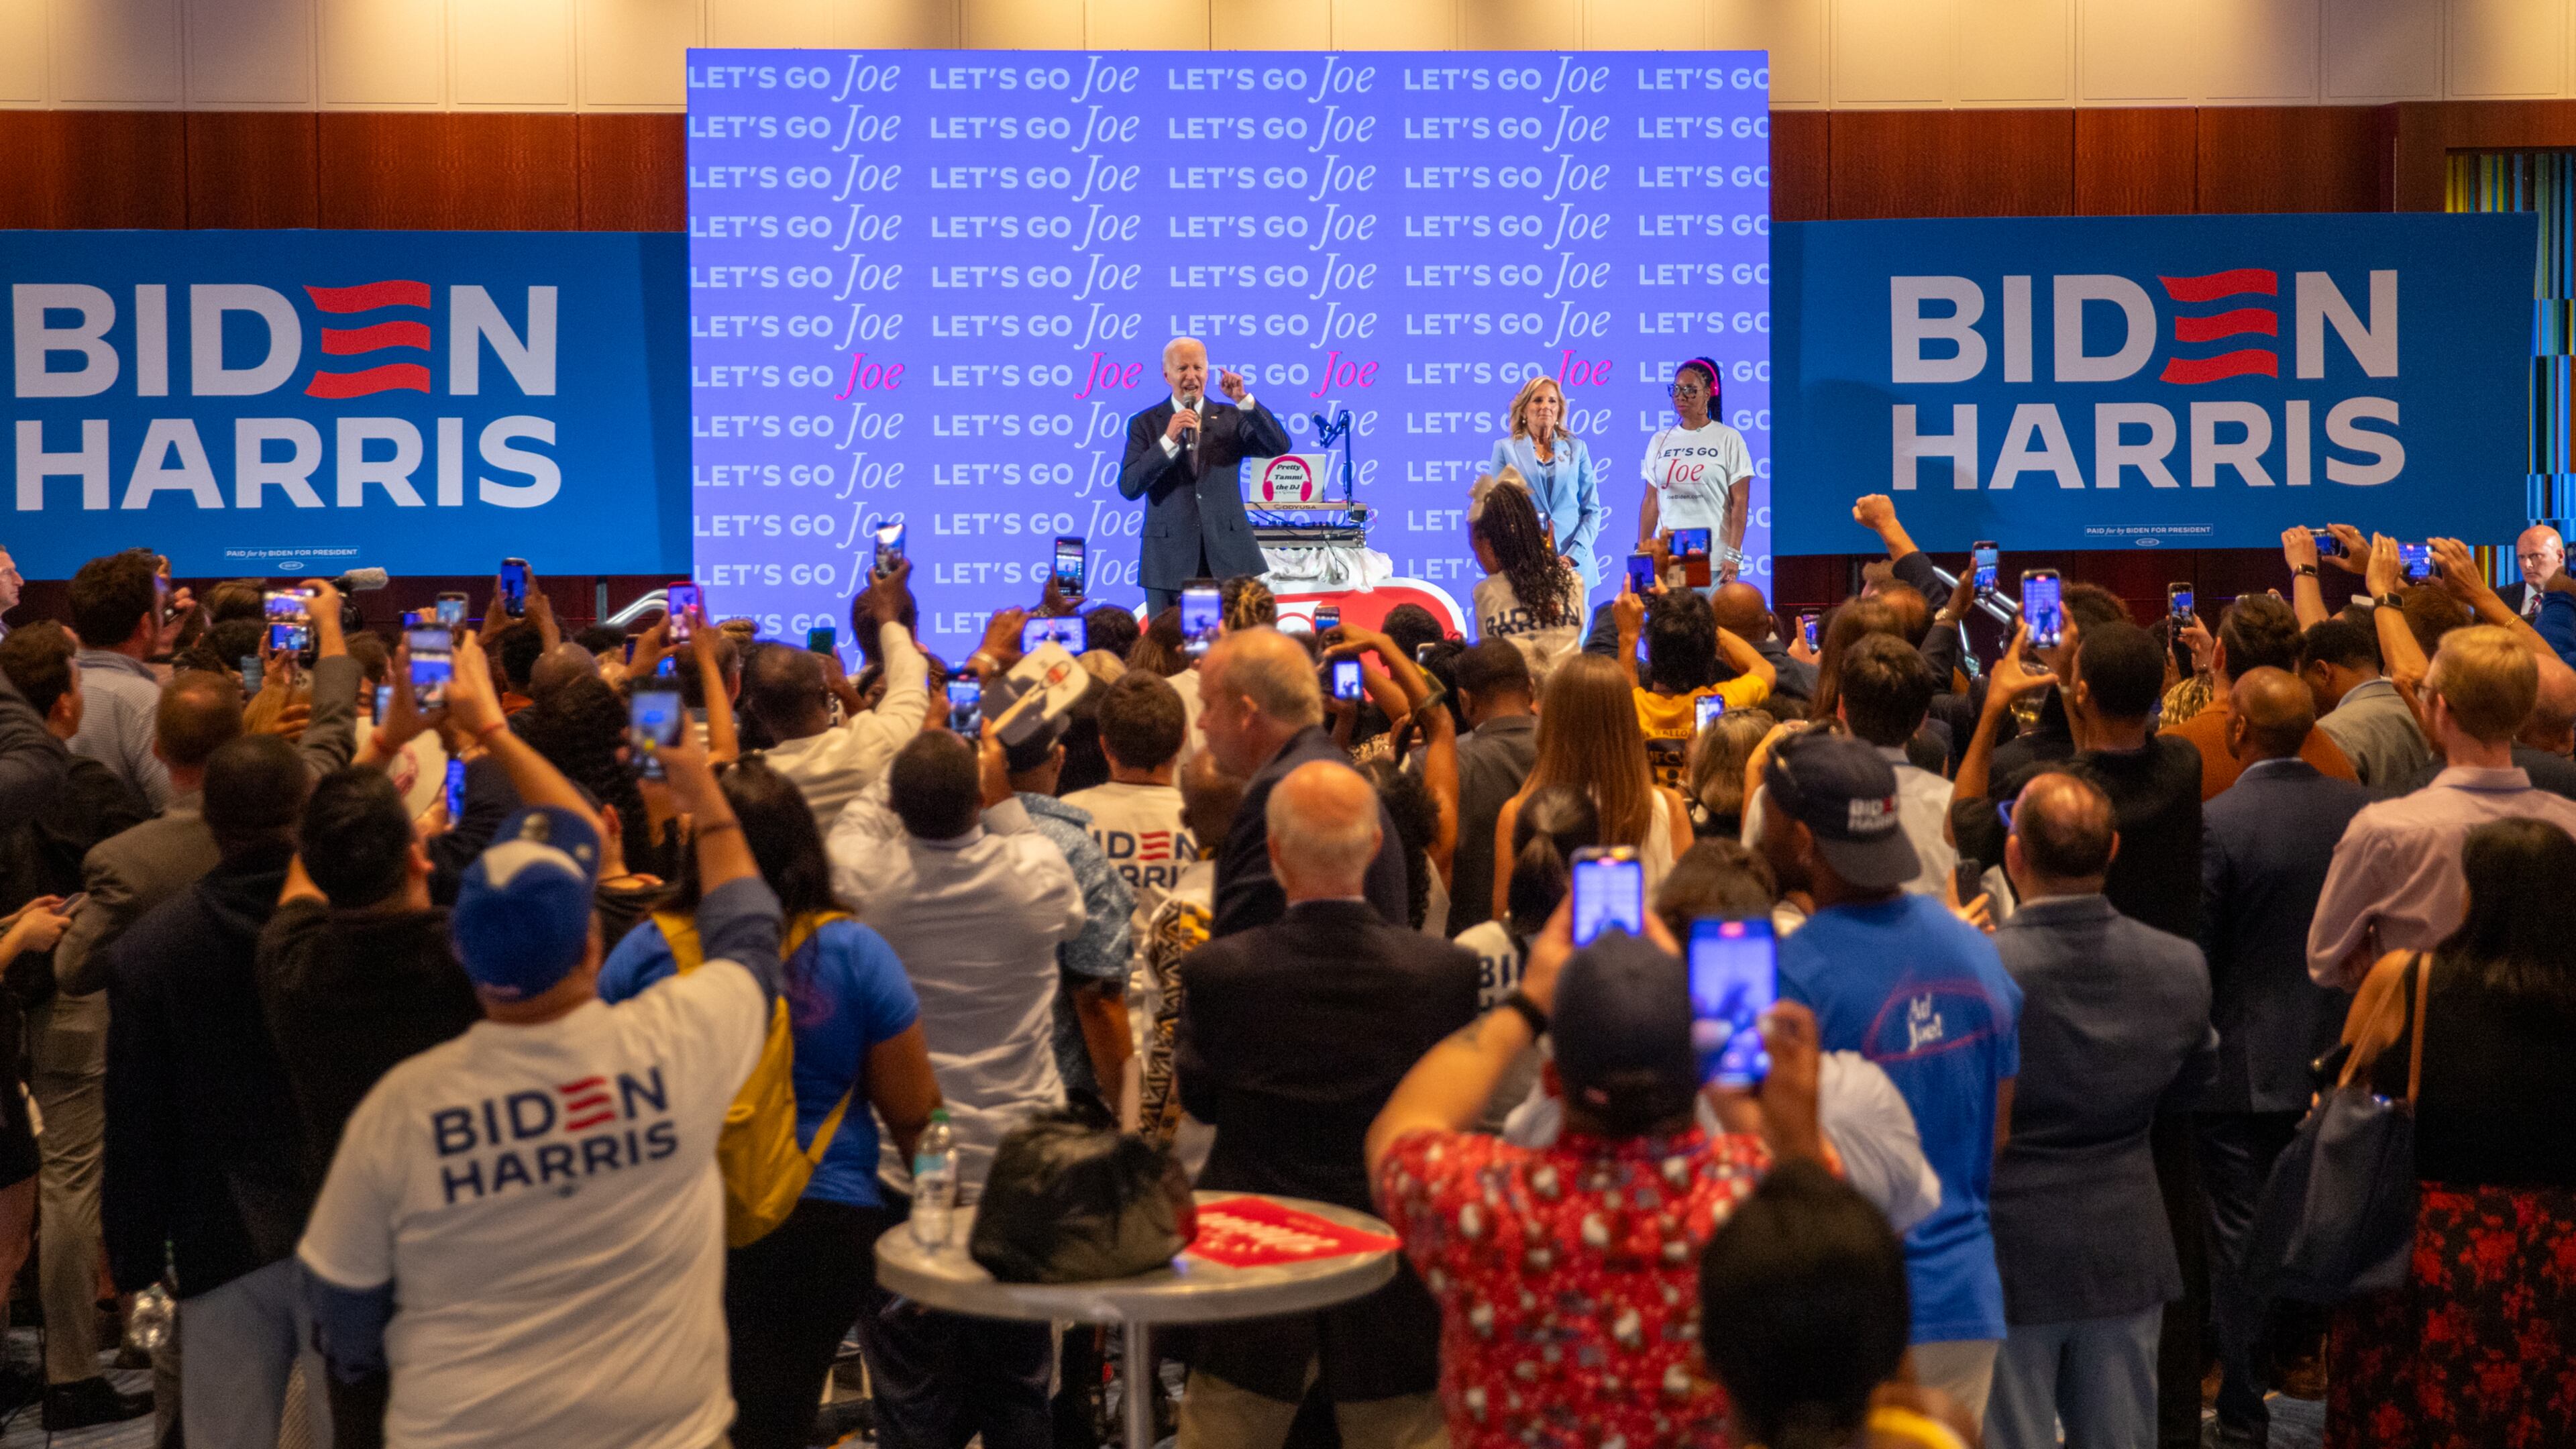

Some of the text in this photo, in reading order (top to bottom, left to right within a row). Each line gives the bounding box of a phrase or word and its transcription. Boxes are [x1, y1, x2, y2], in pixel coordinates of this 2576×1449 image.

[689, 55, 900, 102] LET'S GO Joe
[930, 56, 1139, 103] LET'S GO Joe
[1169, 57, 1375, 103] LET'S GO Joe
[1405, 57, 1609, 103] LET'S GO Joe
[1639, 68, 1723, 89] LET'S
[690, 105, 901, 152] LET'S GO Joe
[931, 106, 1140, 152] LET'S GO Joe
[1169, 106, 1376, 152] LET'S GO Joe
[1405, 106, 1610, 152] LET'S GO Joe
[1639, 117, 1723, 138] LET'S
[690, 154, 901, 201] LET'S GO Joe
[931, 155, 1140, 202] LET'S GO Joe
[1170, 155, 1376, 202] LET'S GO Joe
[1405, 155, 1610, 201] LET'S GO Joe
[1639, 166, 1723, 187] LET'S
[690, 204, 902, 251] LET'S GO Joe
[932, 205, 1140, 251] LET'S GO Joe
[1170, 204, 1377, 251] LET'S GO Joe
[1406, 203, 1610, 250] LET'S GO Joe
[1640, 215, 1723, 235] LET'S
[691, 254, 902, 301] LET'S GO Joe
[932, 254, 1141, 301] LET'S GO Joe
[1171, 253, 1377, 300] LET'S GO Joe
[1406, 252, 1610, 299] LET'S GO Joe
[1640, 264, 1723, 284] LET'S
[11, 280, 557, 399] BIDEN
[692, 303, 903, 350] LET'S GO Joe
[933, 303, 1141, 350] LET'S GO Joe
[1171, 303, 1377, 349] LET'S GO Joe
[1407, 301, 1611, 347] LET'S GO Joe
[1640, 312, 1724, 333] LET'S
[1890, 268, 2398, 384] BIDEN
[692, 353, 903, 400] LET'S GO Joe
[933, 352, 1142, 399] LET'S GO Joe
[1265, 352, 1377, 398] GO Joe
[1407, 363, 1491, 384] LET'S
[1500, 362, 1543, 384] GO
[693, 402, 904, 449] LET'S GO Joe
[934, 414, 1073, 435] LET'S GO
[1407, 412, 1491, 433] LET'S
[1892, 396, 2406, 490] HARRIS
[15, 415, 561, 511] HARRIS
[934, 464, 1073, 485] LET'S GO
[1662, 458, 1705, 489] Joe
[1697, 447, 1718, 457] GO
[694, 452, 904, 499] LET'S GO Joe
[694, 515, 835, 536] LET'S GO
[935, 500, 1143, 544] LET'S GO Joe
[246, 550, 258, 558] for
[694, 565, 782, 586] LET'S
[791, 564, 835, 586] GO
[935, 563, 1022, 584] LET'S
[431, 1065, 669, 1157] BIDEN
[441, 1120, 678, 1204] HARRIS
